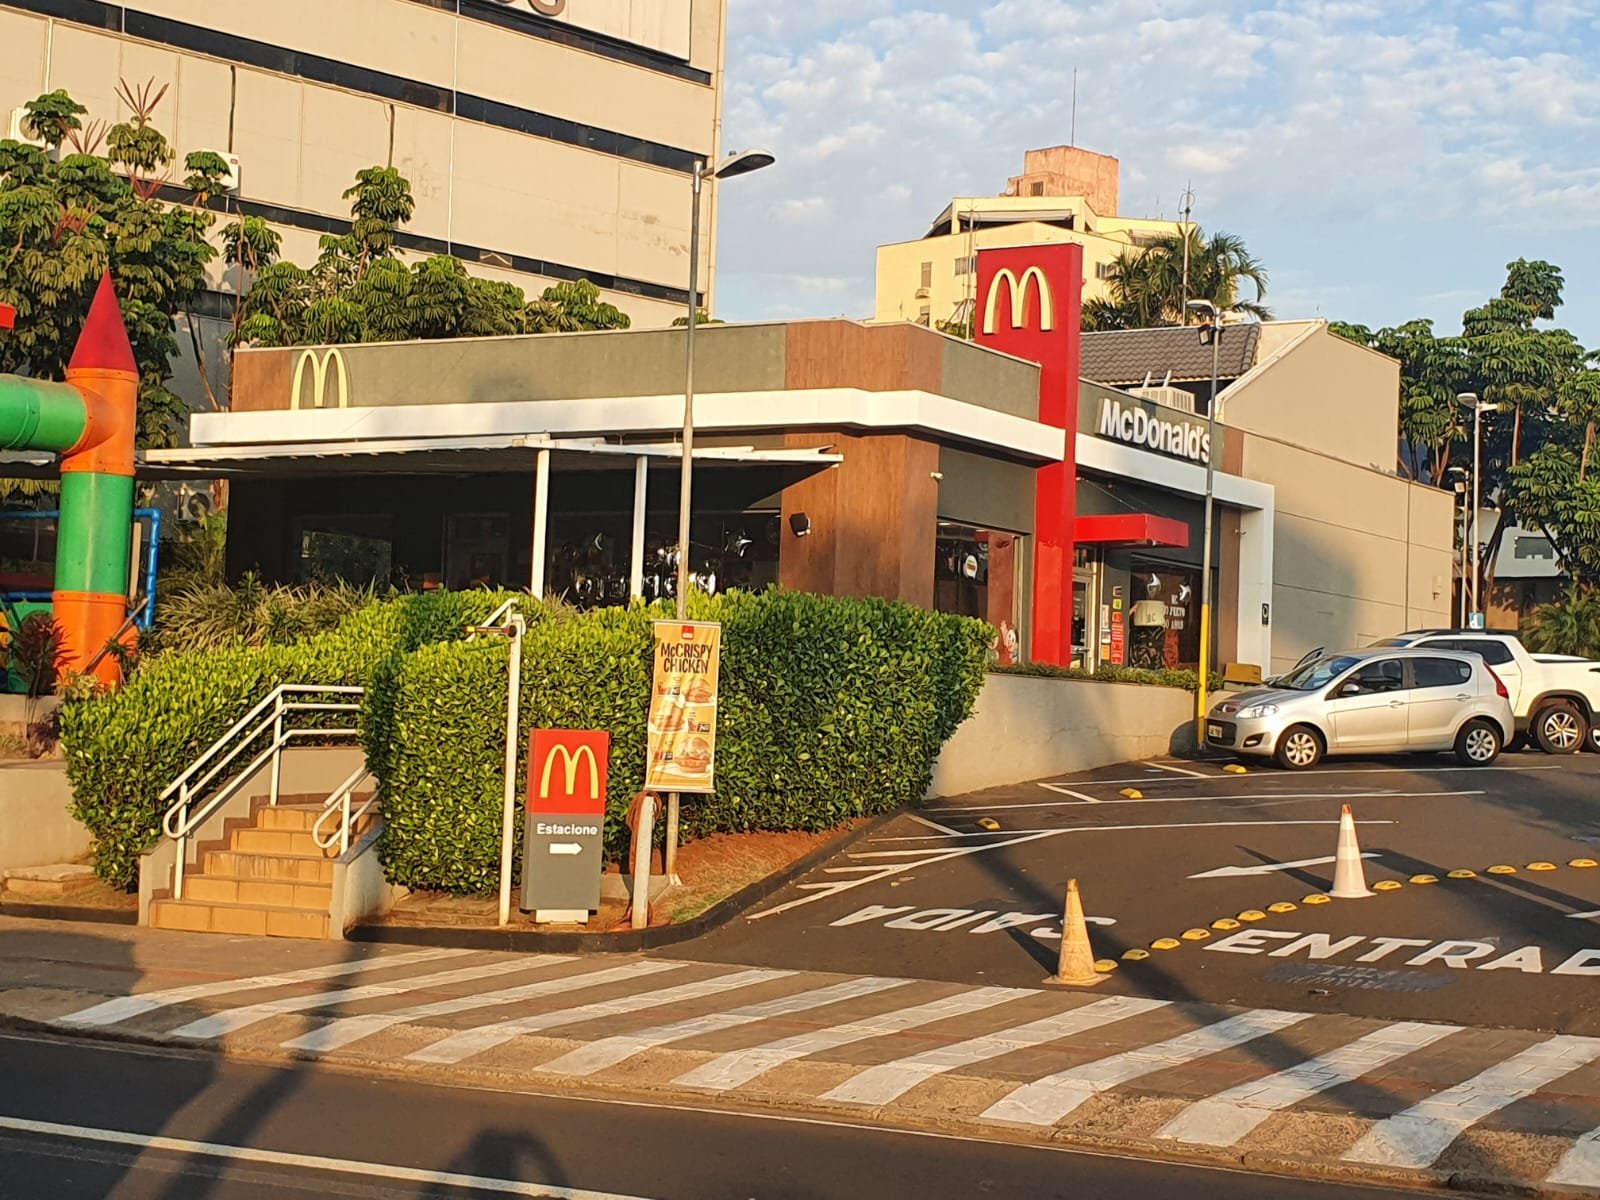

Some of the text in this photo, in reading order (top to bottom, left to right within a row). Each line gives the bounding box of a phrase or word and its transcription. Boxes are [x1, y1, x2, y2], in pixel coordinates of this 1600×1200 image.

[1100, 398, 1210, 463] McDonald's
[661, 642, 713, 659] McCRISPY
[663, 657, 709, 674] CHICKEN
[536, 822, 599, 836] Estacione
